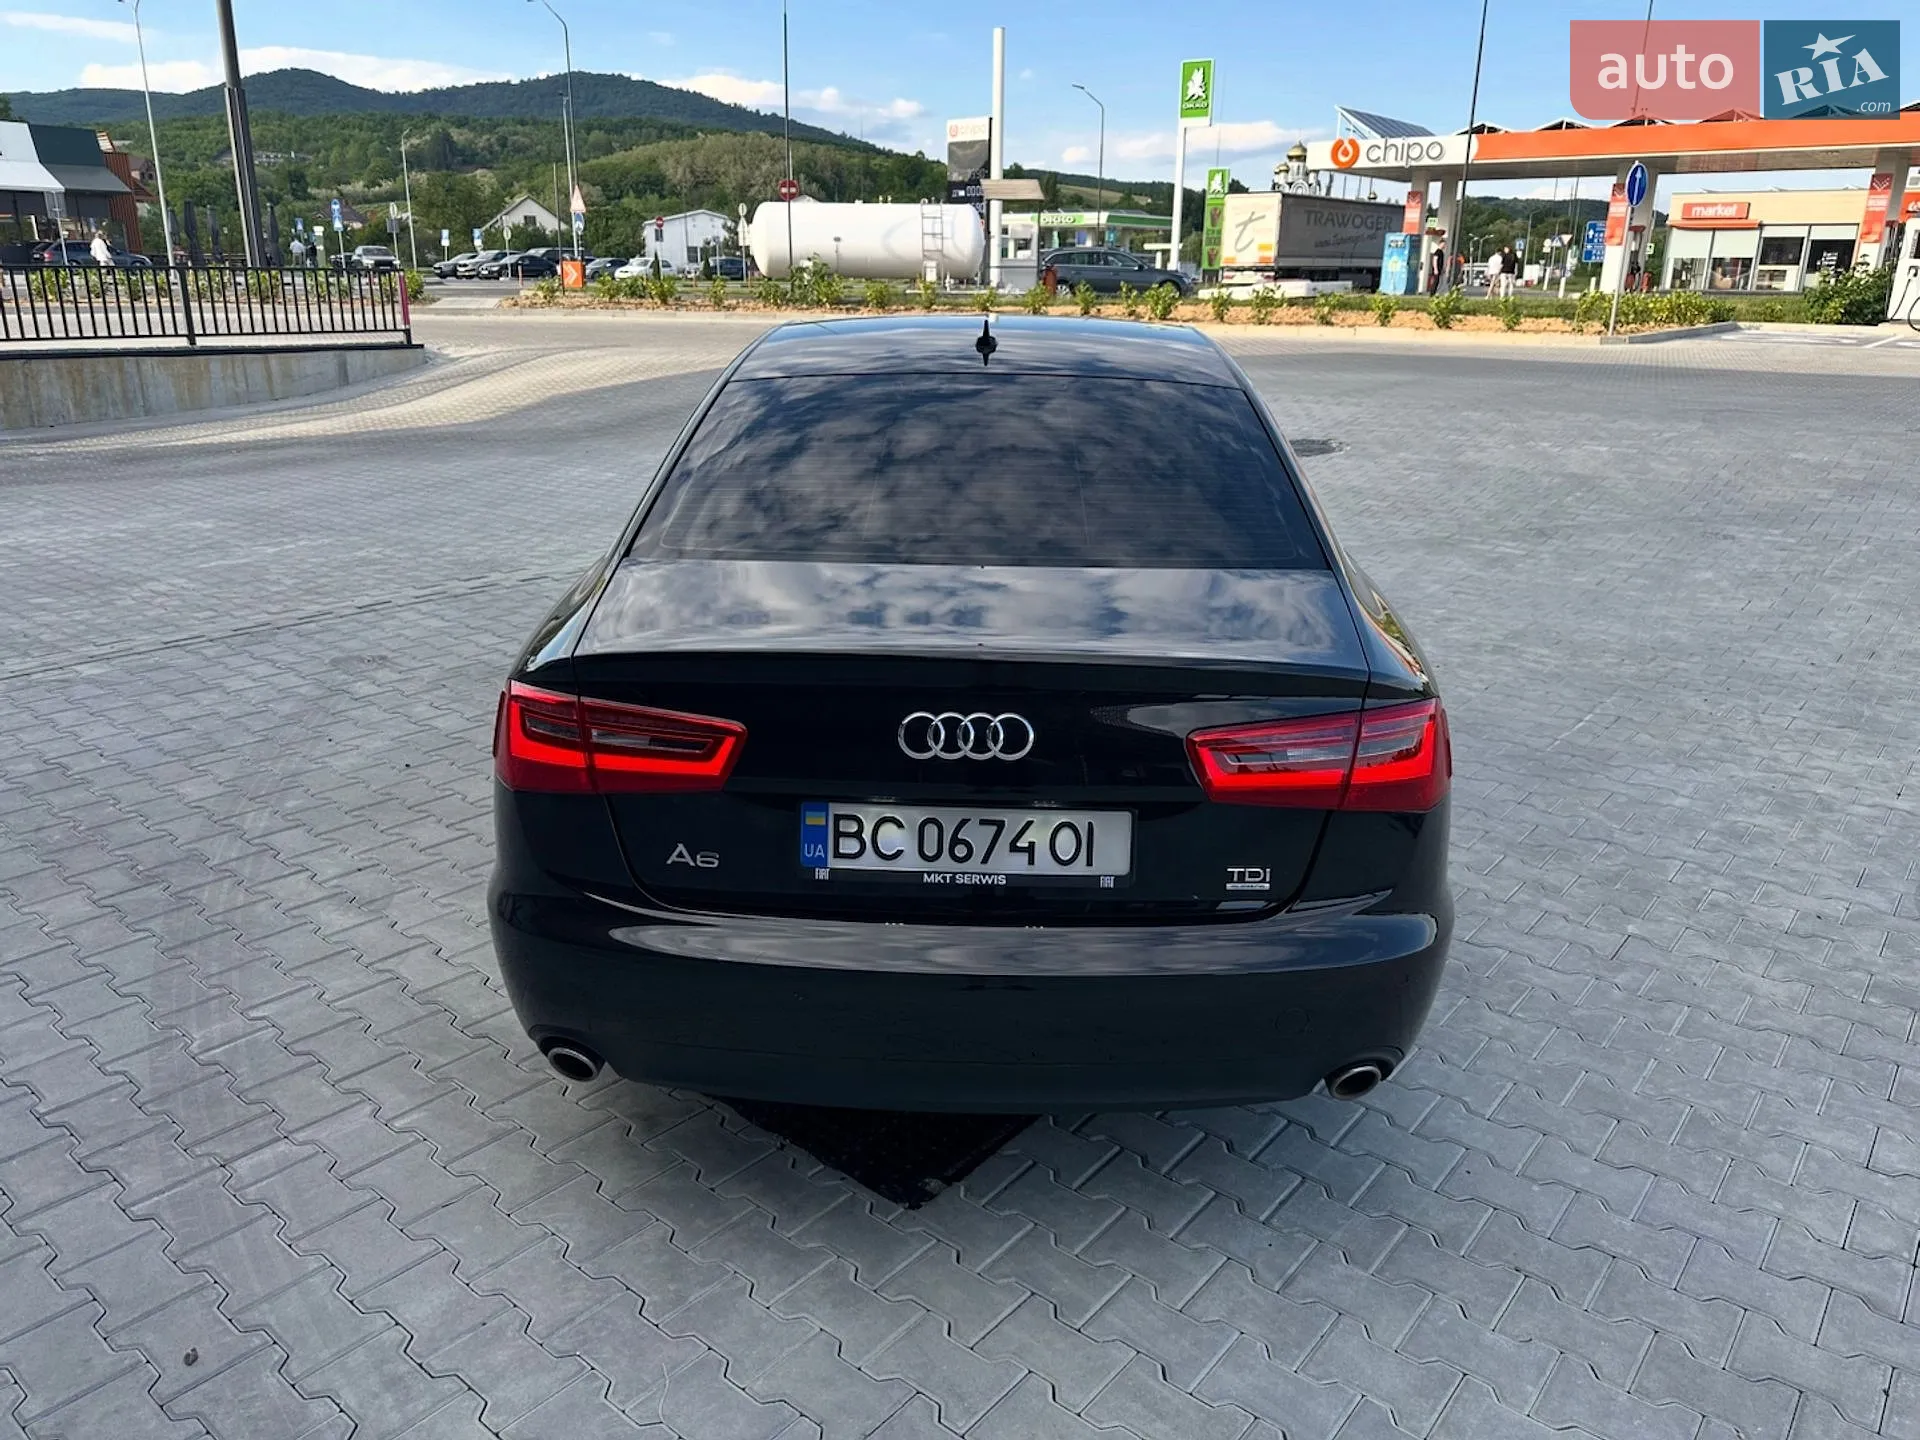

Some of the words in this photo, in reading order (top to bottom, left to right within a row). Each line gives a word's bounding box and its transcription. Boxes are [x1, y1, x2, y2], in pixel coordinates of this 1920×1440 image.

[1366, 136, 1445, 168] chipo
[1691, 204, 1737, 217] market
[833, 813, 905, 861] BC
[917, 817, 1036, 866] 0674
[666, 843, 720, 868] A6
[804, 843, 825, 858] UA
[922, 872, 953, 884] MKT
[955, 873, 1007, 885] SERWIS
[1226, 868, 1271, 882] TDI
